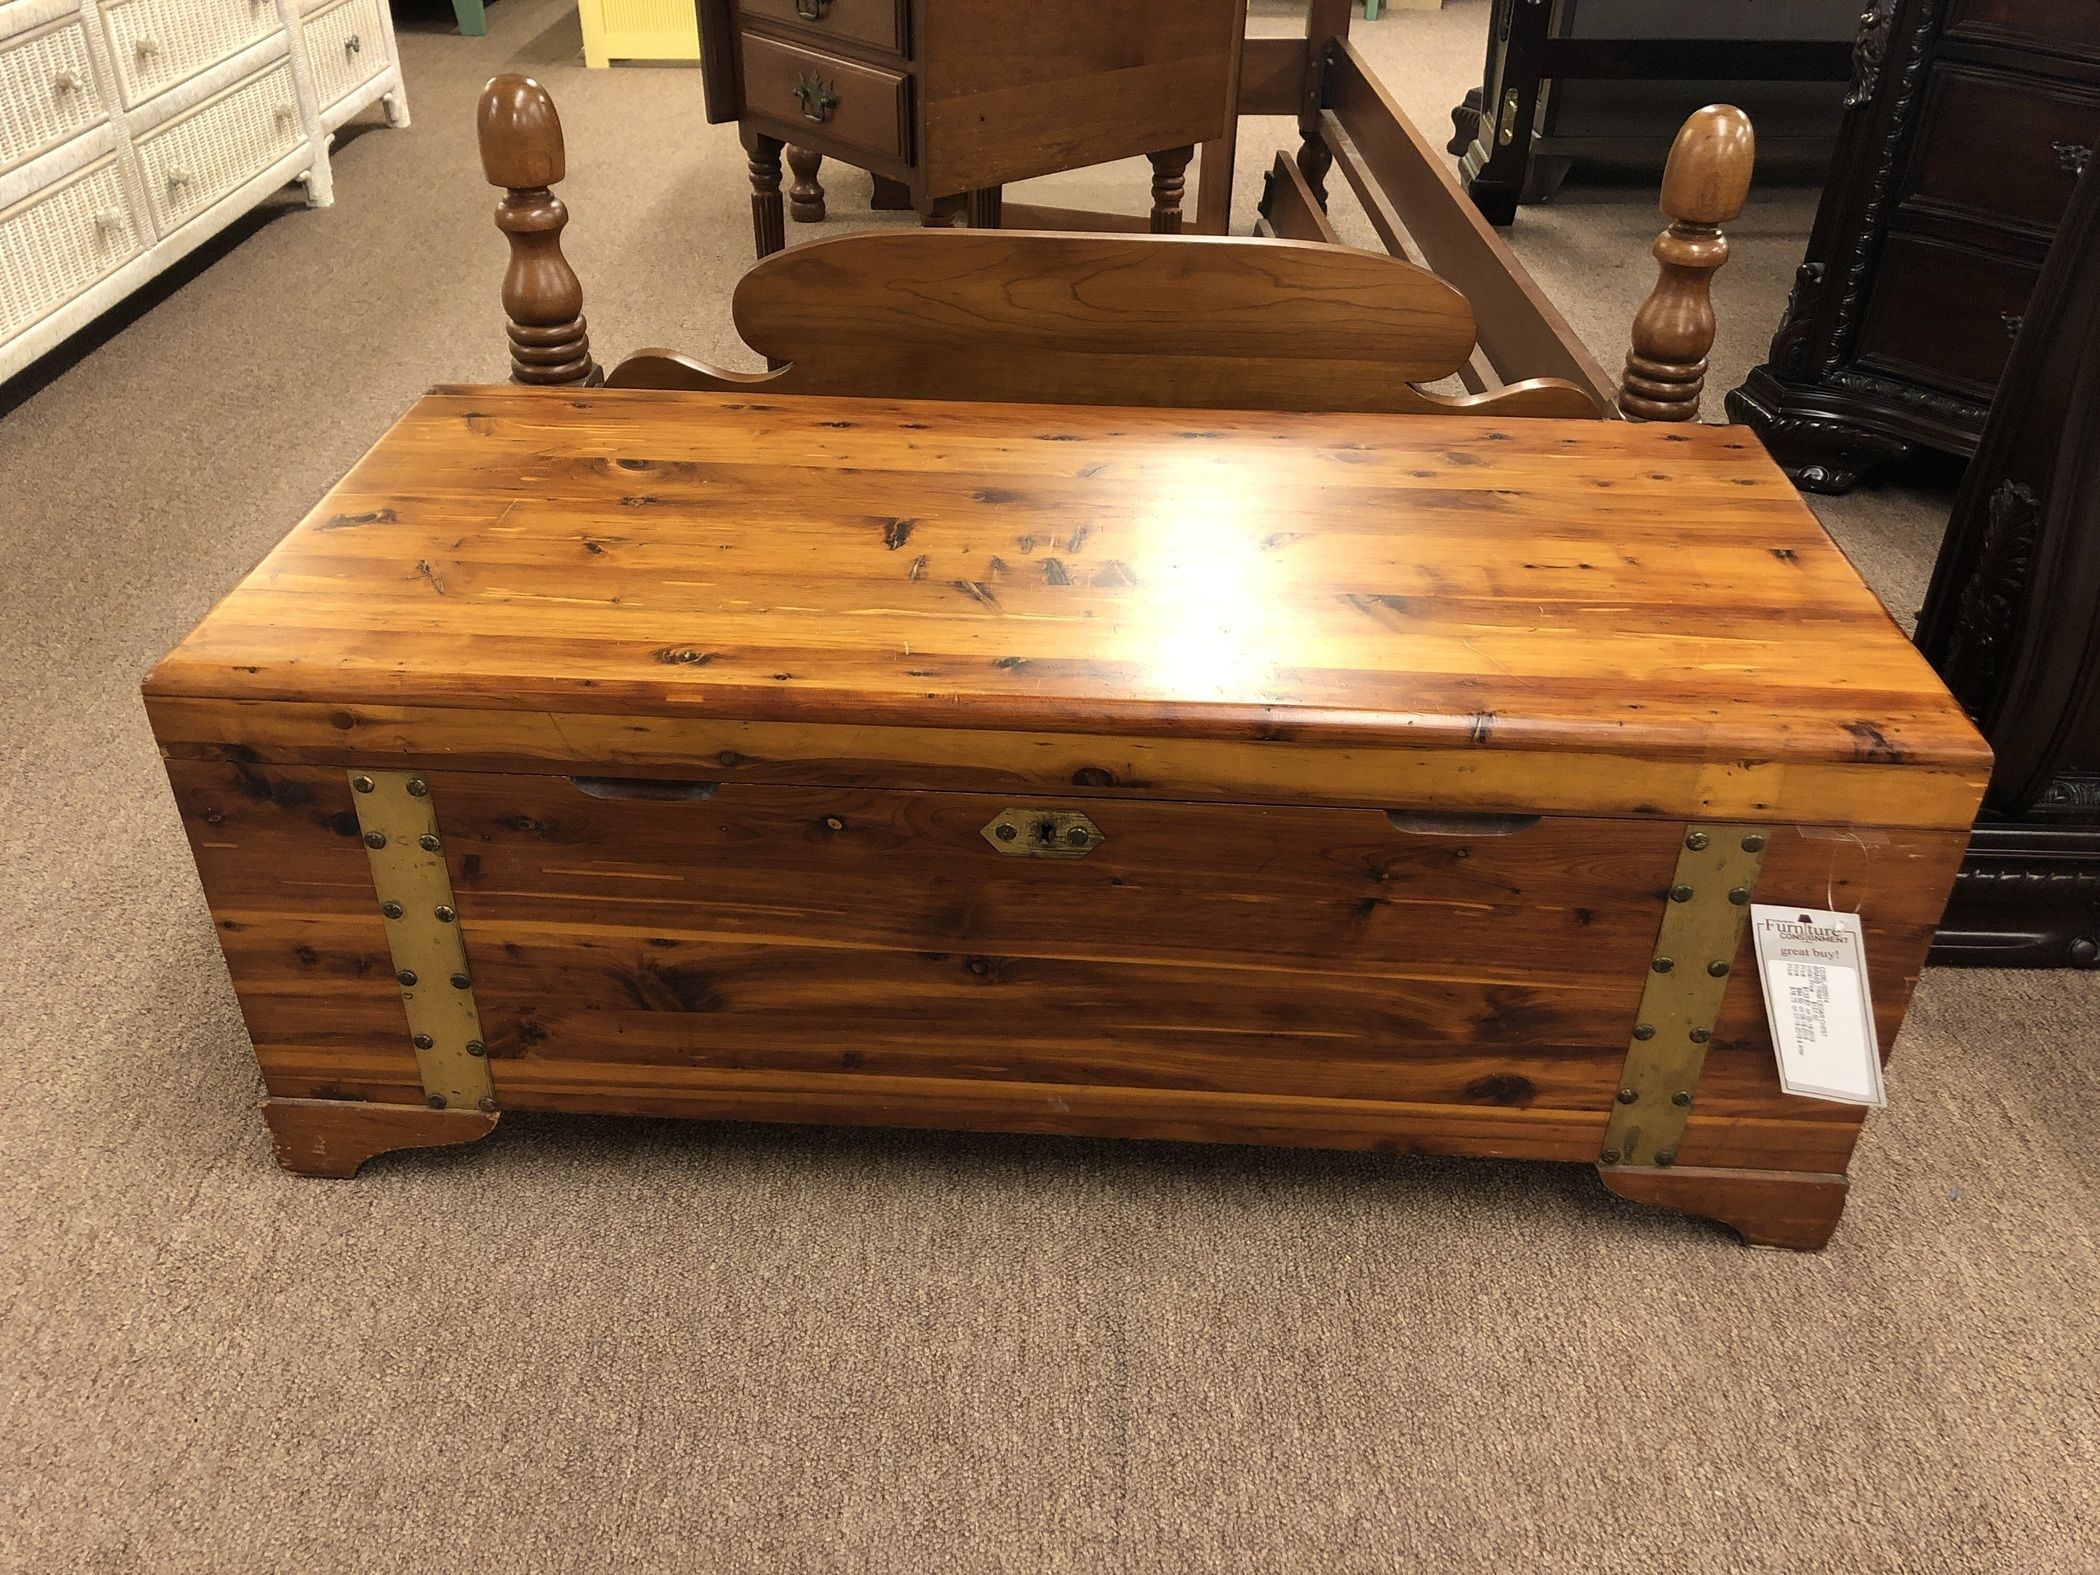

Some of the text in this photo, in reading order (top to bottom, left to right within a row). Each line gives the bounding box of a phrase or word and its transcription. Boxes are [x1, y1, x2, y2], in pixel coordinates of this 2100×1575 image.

[1765, 918, 1842, 937] Furniture
[1779, 932, 1848, 944] CONSIGNMENT
[1780, 947, 1839, 960] great buy!
